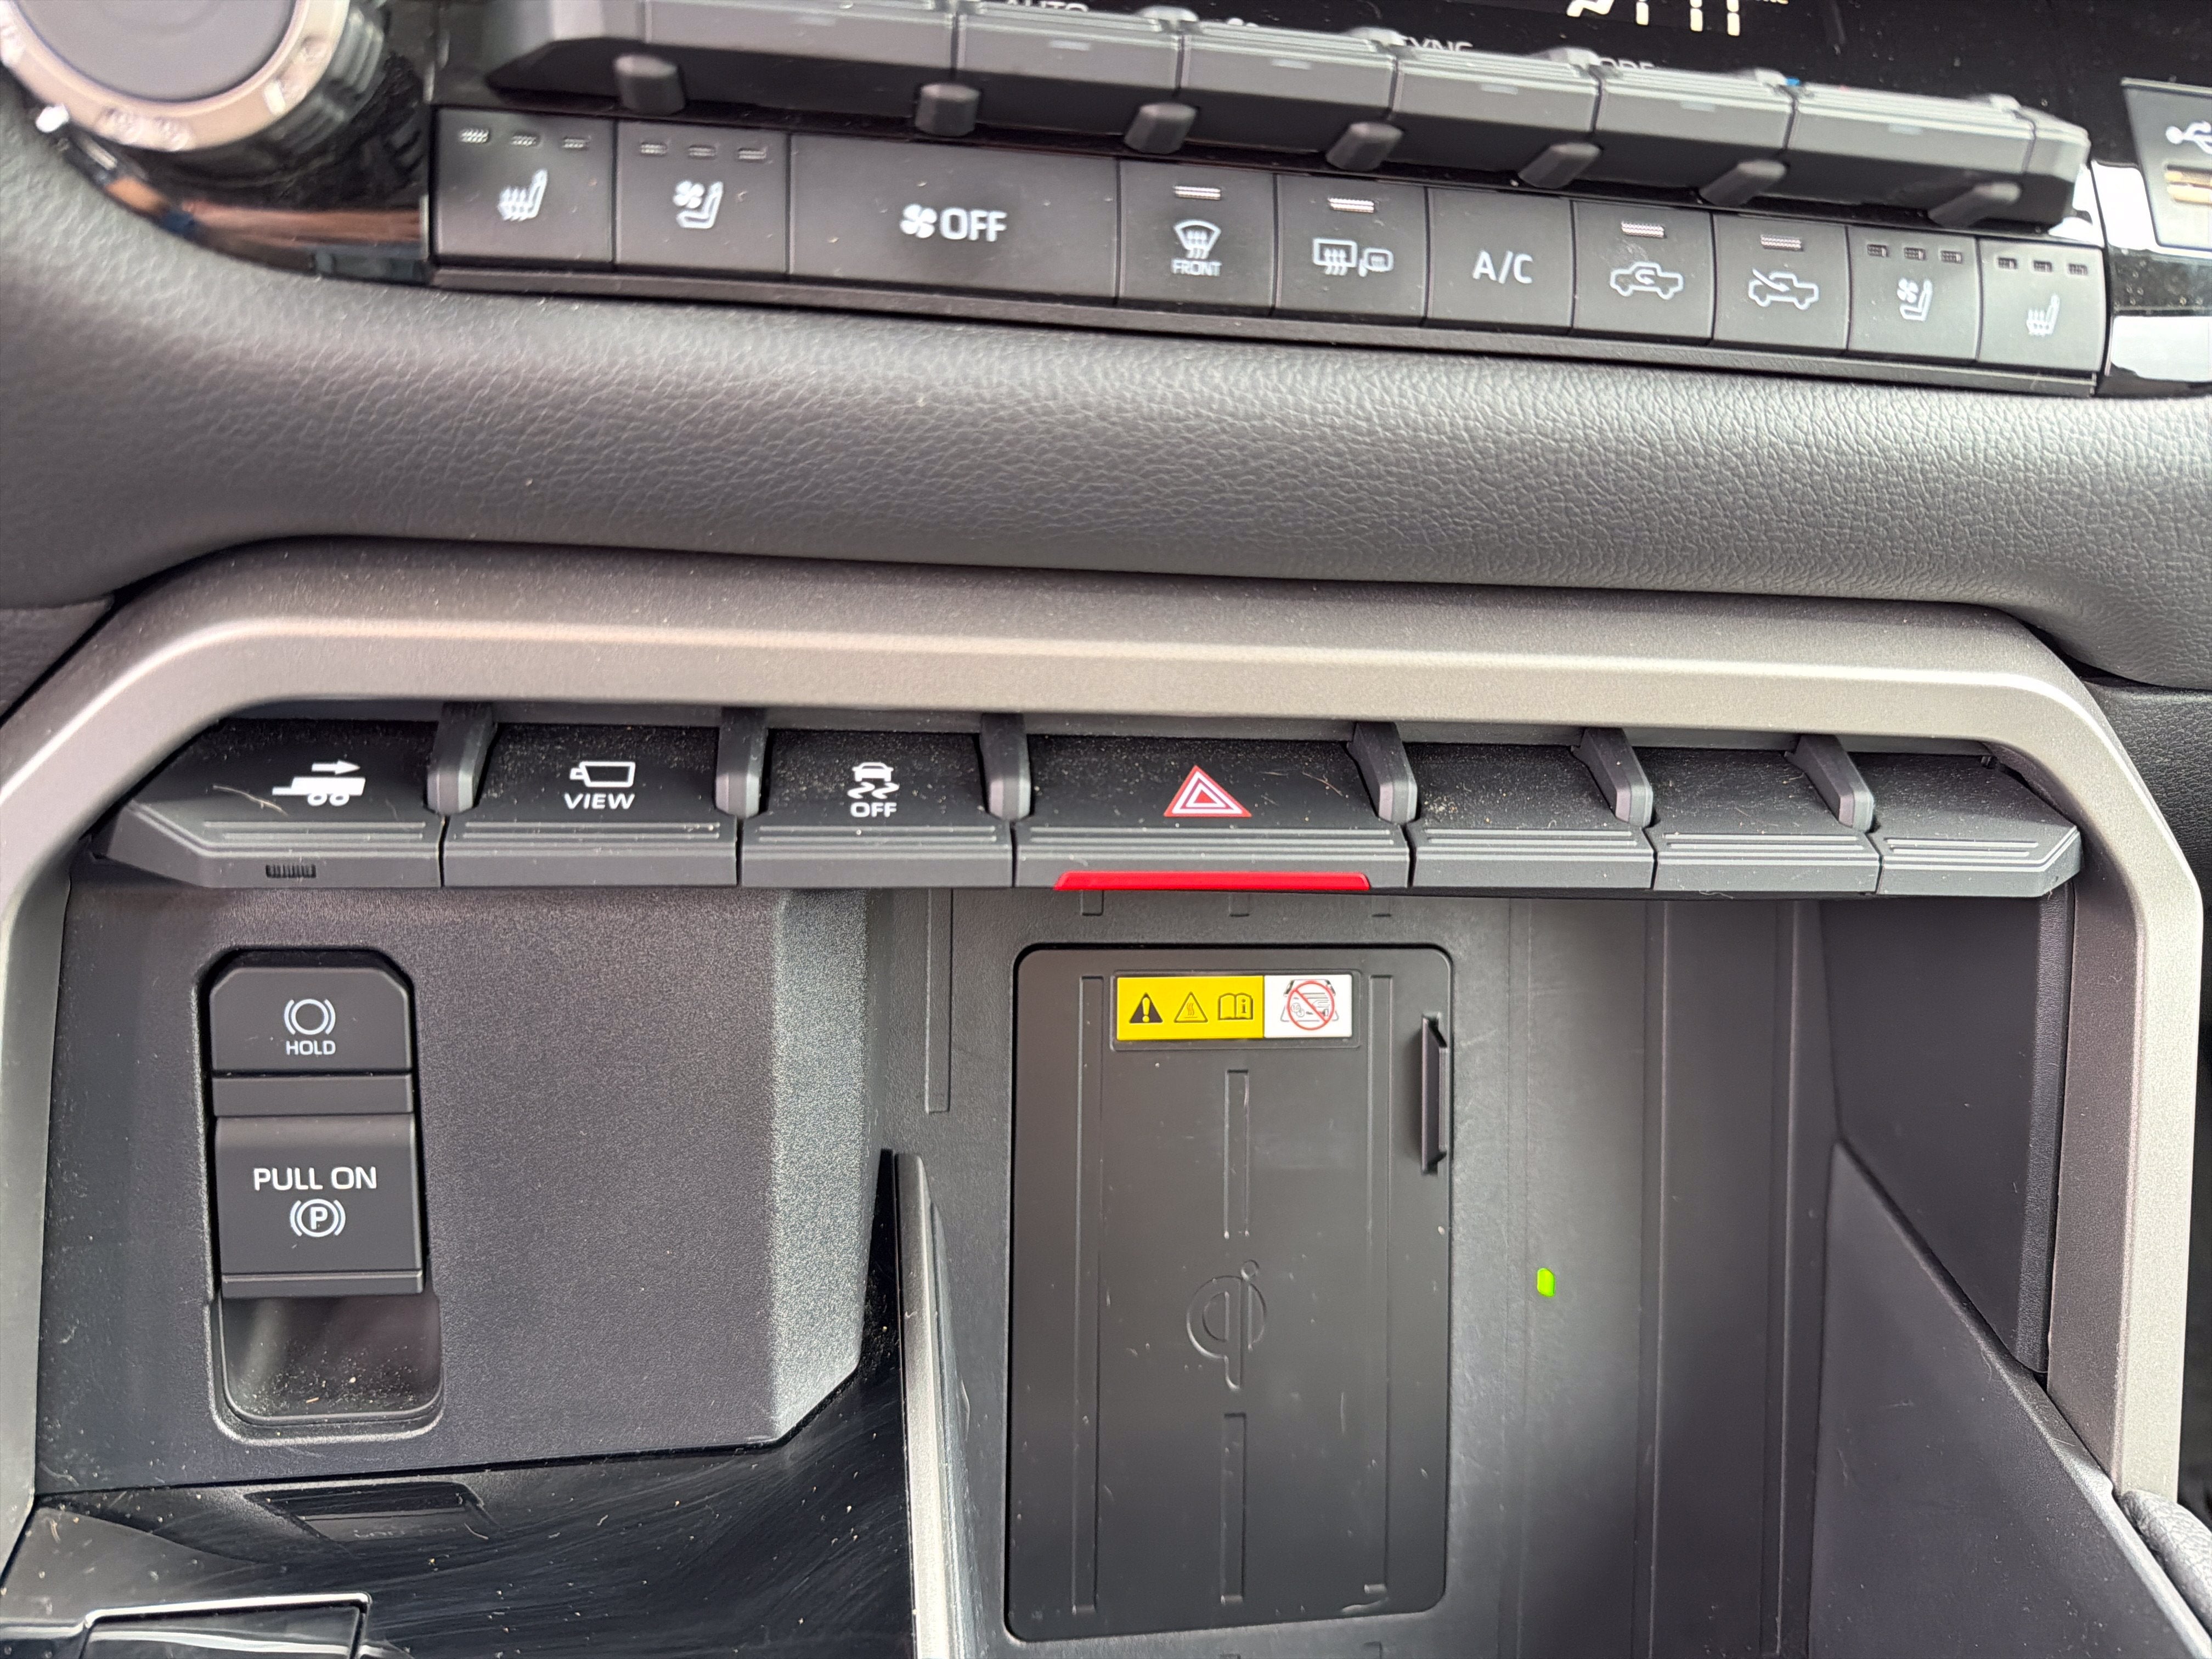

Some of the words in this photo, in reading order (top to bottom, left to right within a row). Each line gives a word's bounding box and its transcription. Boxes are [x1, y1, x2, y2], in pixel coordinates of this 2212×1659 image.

[939, 207, 1008, 242] OFF
[1171, 259, 1222, 276] FRONT
[1472, 250, 1534, 284] A/C
[564, 793, 635, 810] VIEW
[850, 802, 897, 817] OFF
[286, 1040, 336, 1055] HOLD
[253, 1167, 323, 1191] PULL
[331, 1166, 377, 1189] ON
[310, 1206, 328, 1229] P
